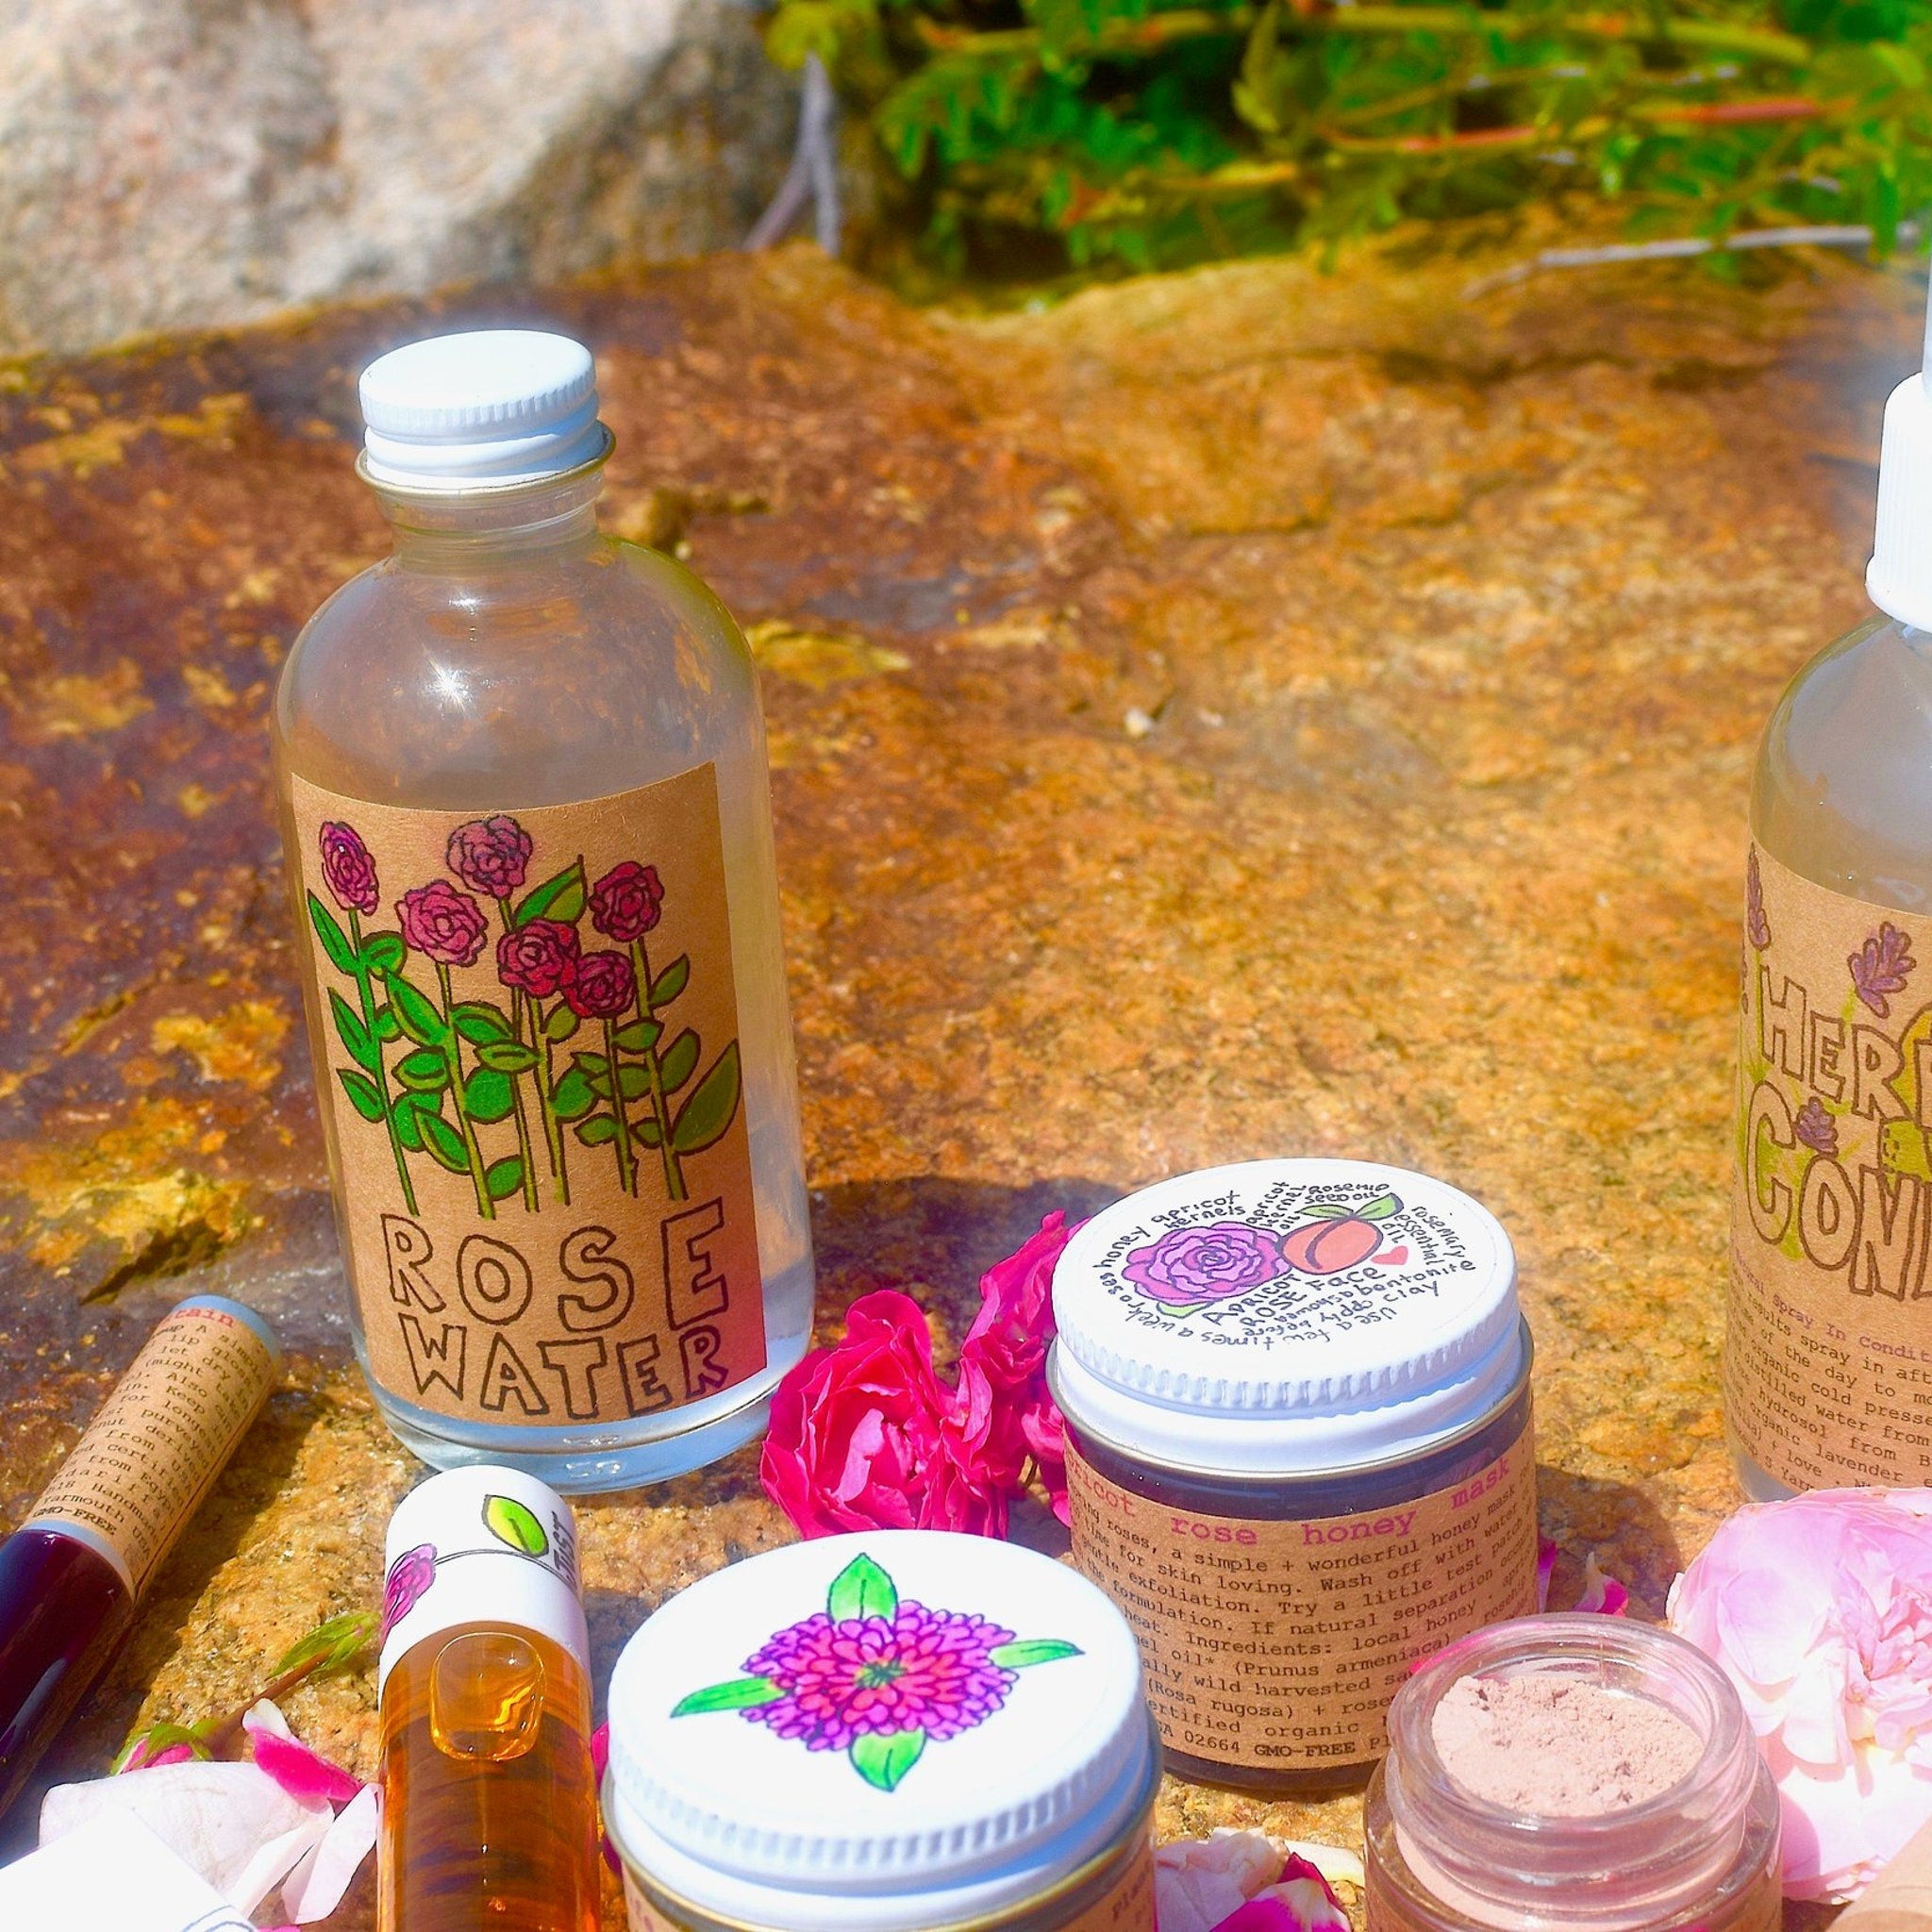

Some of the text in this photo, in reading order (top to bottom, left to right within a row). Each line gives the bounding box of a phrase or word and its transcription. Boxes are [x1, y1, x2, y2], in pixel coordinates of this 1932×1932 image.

[1151, 1190, 1241, 1224] apricot
[380, 1195, 730, 1334] ROSE
[1092, 1226, 1151, 1268] honey
[1241, 1289, 1308, 1327] ROSE
[1383, 1279, 1441, 1304] clay
[1202, 1331, 1274, 1351] times
[1283, 1327, 1331, 1343] few
[1800, 1334, 1851, 1366] spray
[1862, 1357, 1885, 1375] in
[166, 1372, 208, 1398] Also
[202, 1356, 231, 1382] dry
[397, 1312, 730, 1420] WATER
[1785, 1345, 1811, 1368] the
[1824, 1365, 1857, 1390] day
[1874, 1380, 1896, 1397] to
[165, 1385, 206, 1416] Keep
[1810, 1381, 1852, 1407] cold
[106, 1428, 156, 1451] from
[1758, 1386, 1828, 1440] hydrosol
[1849, 1437, 1898, 1461] from
[1919, 1453, 1932, 1468] B
[1814, 1404, 1870, 1433] water
[1882, 1424, 1930, 1447] from
[89, 1454, 132, 1472] from
[1787, 1448, 1823, 1477] love
[1815, 1443, 1905, 1483] lavender
[32, 1506, 118, 1536] GMO-FREE
[1170, 1516, 1258, 1546] rose
[1301, 1510, 1418, 1545] honey
[1450, 1457, 1509, 1510] mask
[1108, 1522, 1157, 1555] roses,
[1172, 1548, 1183, 1560] a
[1194, 1552, 1268, 1574] simple
[1282, 1560, 1294, 1572] +
[1307, 1539, 1421, 1572] wonderful
[1431, 1513, 1481, 1545] honey
[1119, 1543, 1146, 1567] for
[1158, 1562, 1202, 1585] skin
[1218, 1574, 1302, 1597] loving.
[1320, 1573, 1374, 1591] Wash
[1387, 1558, 1423, 1580] off
[1435, 1537, 1475, 1565] with
[1128, 1572, 1259, 1613] exfoliation.
[1277, 1601, 1318, 1618] Try
[1333, 1600, 1346, 1612] a
[1361, 1579, 1434, 1607] little
[1445, 1553, 1483, 1582] test
[1113, 1577, 1233, 1631] formulation.
[1250, 1621, 1276, 1635] If
[1289, 1612, 1378, 1636] natural
[1392, 1568, 1493, 1623] separation
[1124, 1605, 1169, 1637] heat.
[1185, 1630, 1332, 1657] Ingredients:
[1352, 1625, 1412, 1652] local
[1425, 1599, 1476, 1632] honey
[1234, 1661, 1320, 1677] (Prunus
[1335, 1631, 1452, 1675] armeniaca)
[1142, 1657, 1413, 1697] ally wild harvested sa
[1148, 1677, 1396, 1719] (Rosa rugosa) + rose
[1146, 1699, 1241, 1734] ertified
[1264, 1720, 1360, 1740] organic
[1184, 1729, 1241, 1754] 02664
[1254, 1740, 1357, 1757] GMO-FREE
[1369, 1736, 1391, 1750] Pl
